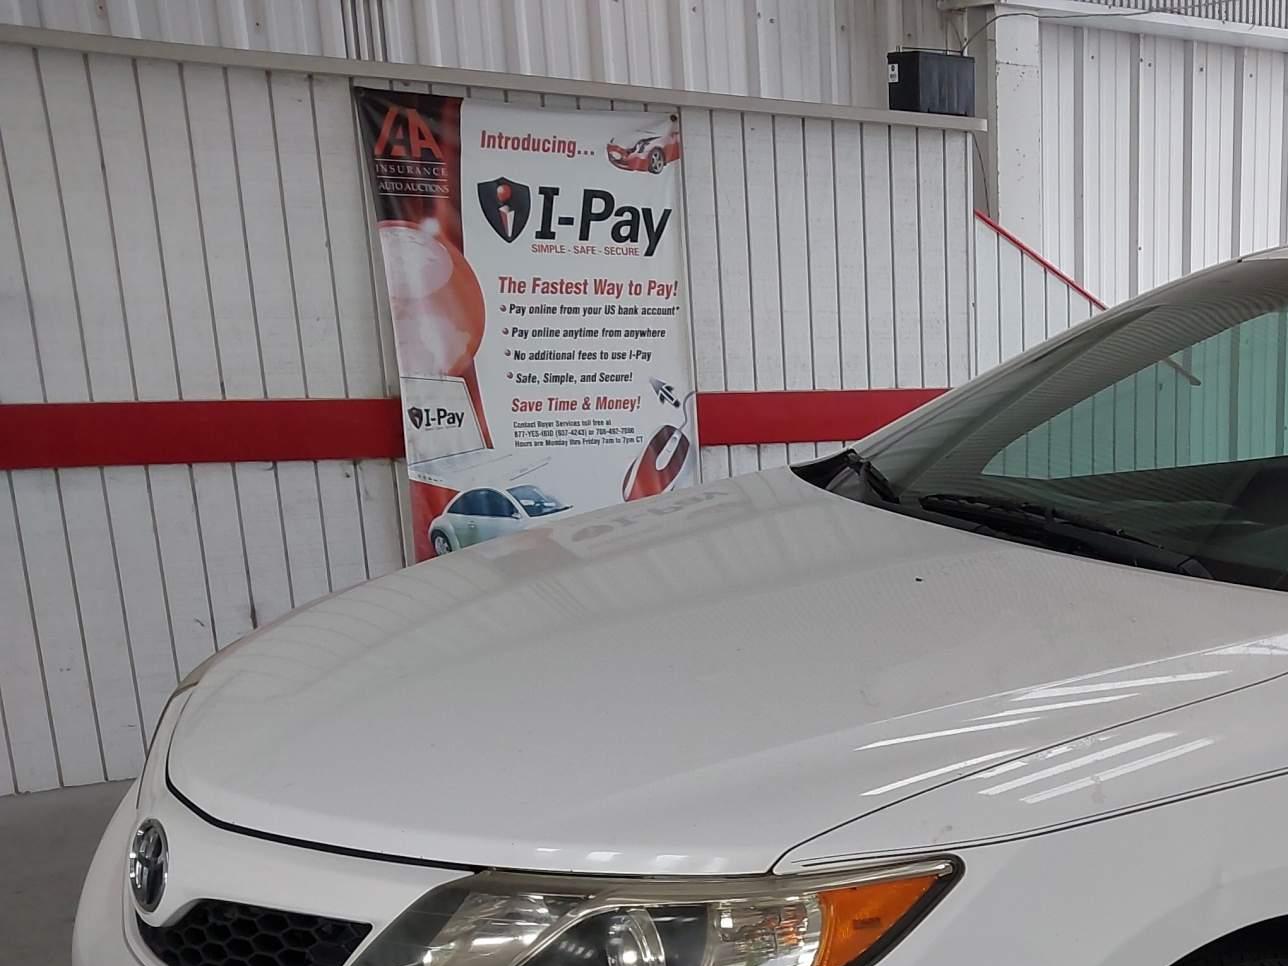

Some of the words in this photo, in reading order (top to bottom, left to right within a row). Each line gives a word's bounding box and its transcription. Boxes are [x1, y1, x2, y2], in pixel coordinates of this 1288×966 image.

[481, 130, 595, 158] Introducing...
[375, 164, 448, 177] INSURANCE
[379, 181, 402, 192] AUTO
[404, 183, 449, 194] AUCTIONS
[534, 186, 672, 257] I-Pay
[531, 244, 566, 254] SIMPLE
[573, 245, 596, 255] SAFE
[604, 246, 640, 256] SECURE
[499, 277, 526, 294] The
[531, 277, 588, 295] Fastest
[594, 279, 623, 299] Way
[628, 280, 642, 296] to
[647, 280, 678, 299] Pay!
[509, 304, 526, 316] Pay
[529, 304, 557, 315] online
[560, 304, 580, 315] from
[582, 306, 601, 317] your
[604, 305, 616, 315] US
[618, 304, 638, 315] bank
[511, 327, 529, 339] Pay
[532, 326, 560, 338] online
[563, 327, 599, 339] anytime
[601, 327, 622, 338] from
[624, 327, 666, 339] anywhere
[513, 350, 526, 361] No
[529, 349, 575, 361] additional
[577, 350, 597, 360] fees
[600, 350, 609, 360] to
[611, 352, 627, 360] use
[629, 350, 651, 361] I-Pay
[515, 372, 540, 385] Safe,
[543, 372, 577, 385] Simple,
[580, 372, 597, 383] and
[599, 371, 633, 382] Secure!
[512, 398, 542, 412] Save
[547, 397, 577, 411] Time
[582, 396, 591, 410] &
[596, 396, 641, 412] Money!
[424, 408, 464, 428] I-Pay
